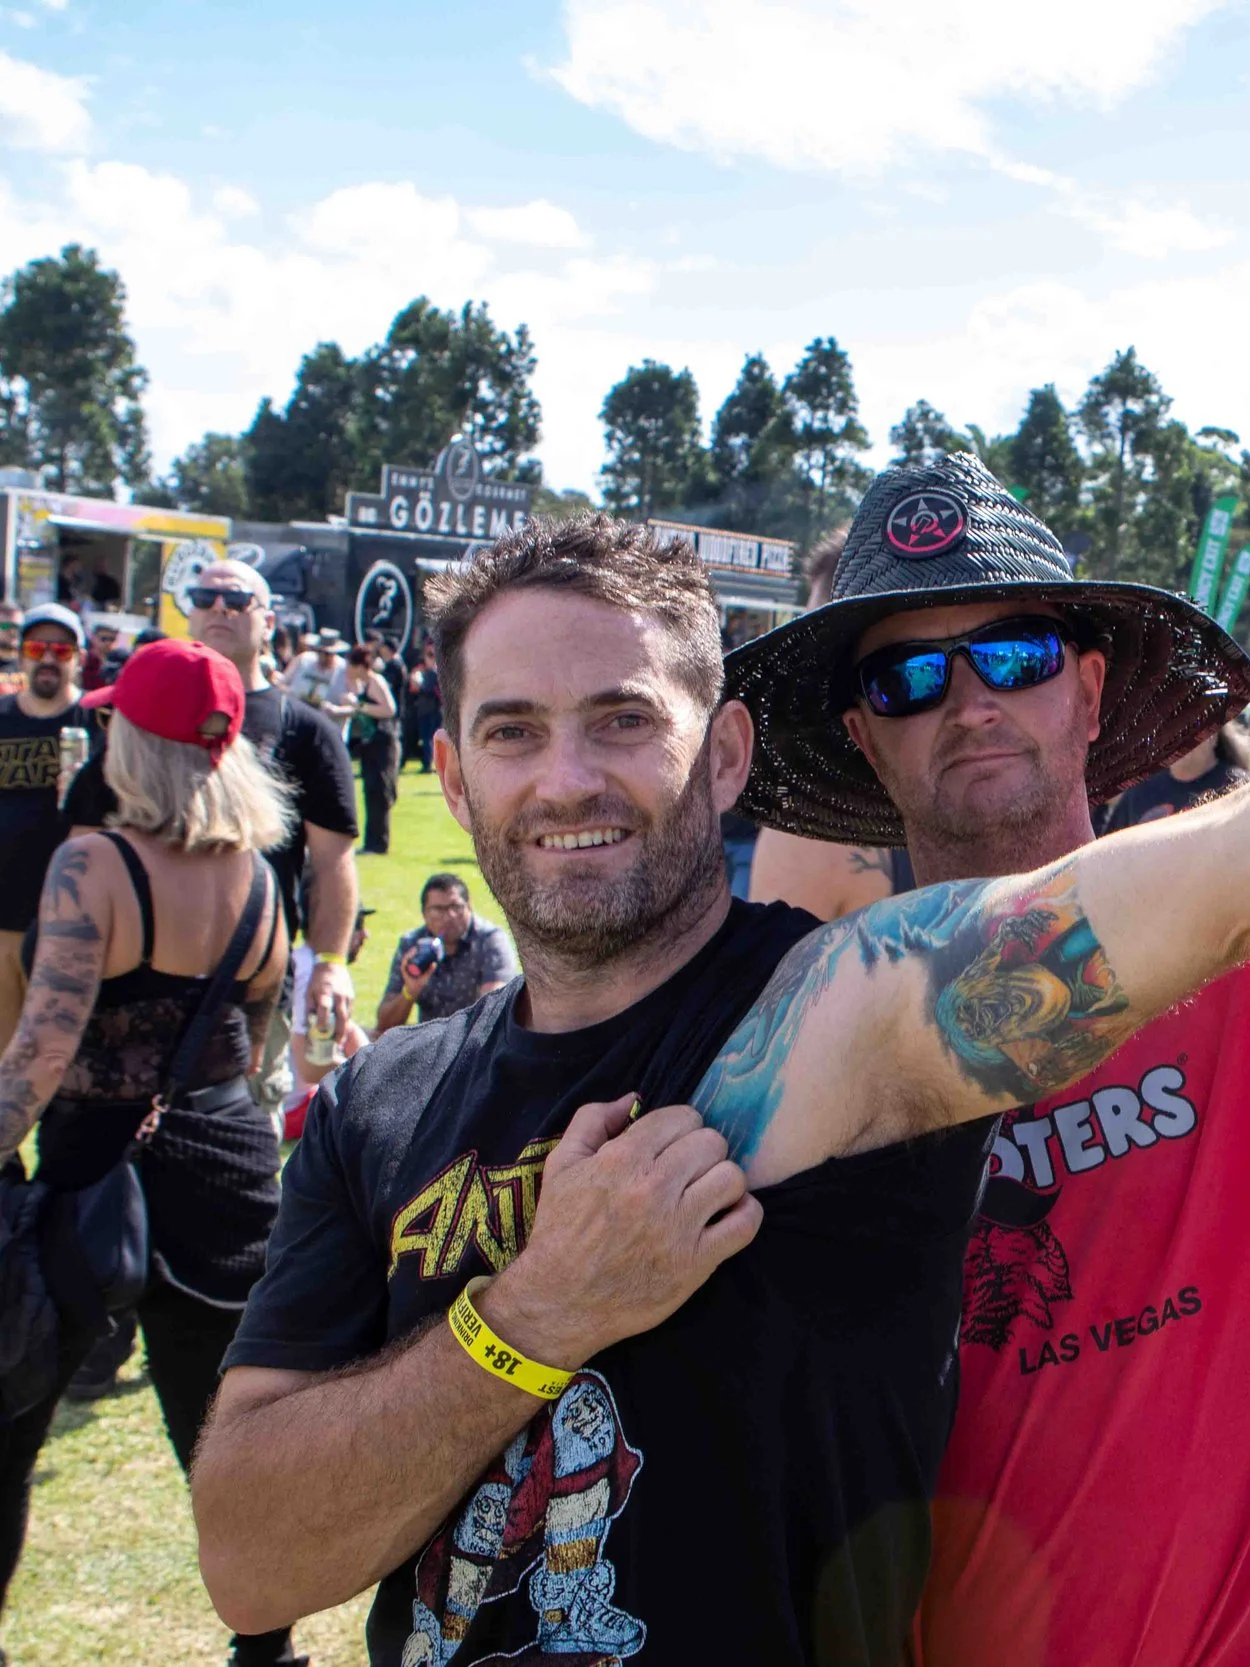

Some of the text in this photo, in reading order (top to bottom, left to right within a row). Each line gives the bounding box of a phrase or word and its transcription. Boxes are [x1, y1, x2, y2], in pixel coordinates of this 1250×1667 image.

[988, 1063, 1197, 1189] OTERS
[387, 1146, 552, 1281] ANT
[484, 1340, 523, 1376] 18+
[1018, 1286, 1202, 1376] LAS VEGAS
